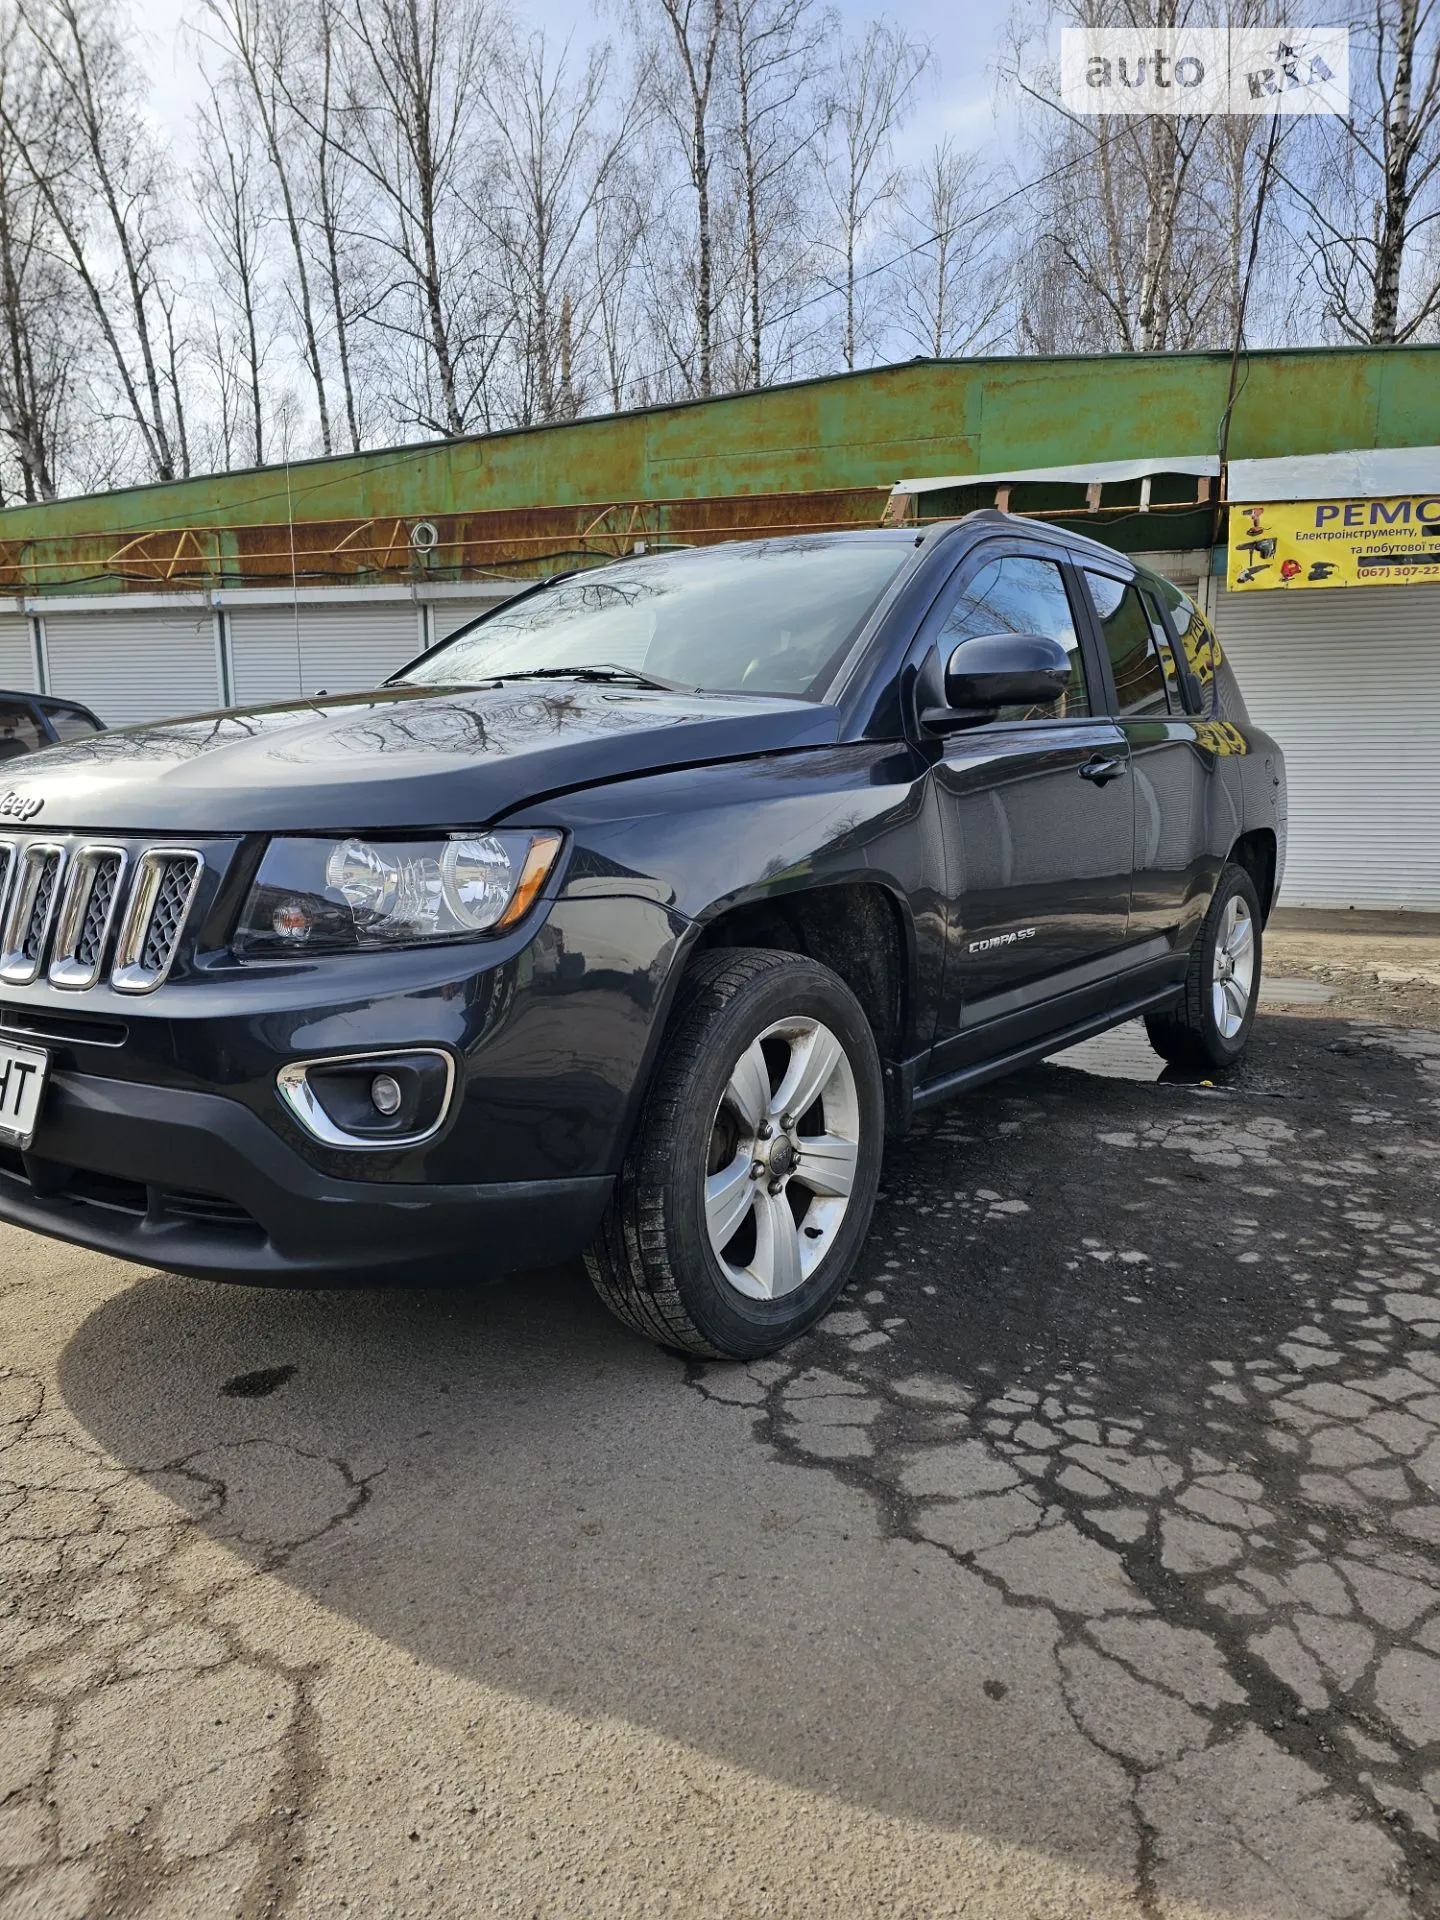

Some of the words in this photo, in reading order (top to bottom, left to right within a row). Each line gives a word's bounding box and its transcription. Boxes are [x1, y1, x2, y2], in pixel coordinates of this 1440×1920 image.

[1295, 528, 1417, 541] Електроінструменту,
[1366, 542, 1425, 554] побутової
[1357, 567, 1390, 579] (067)
[969, 928, 1036, 953] COMPASS
